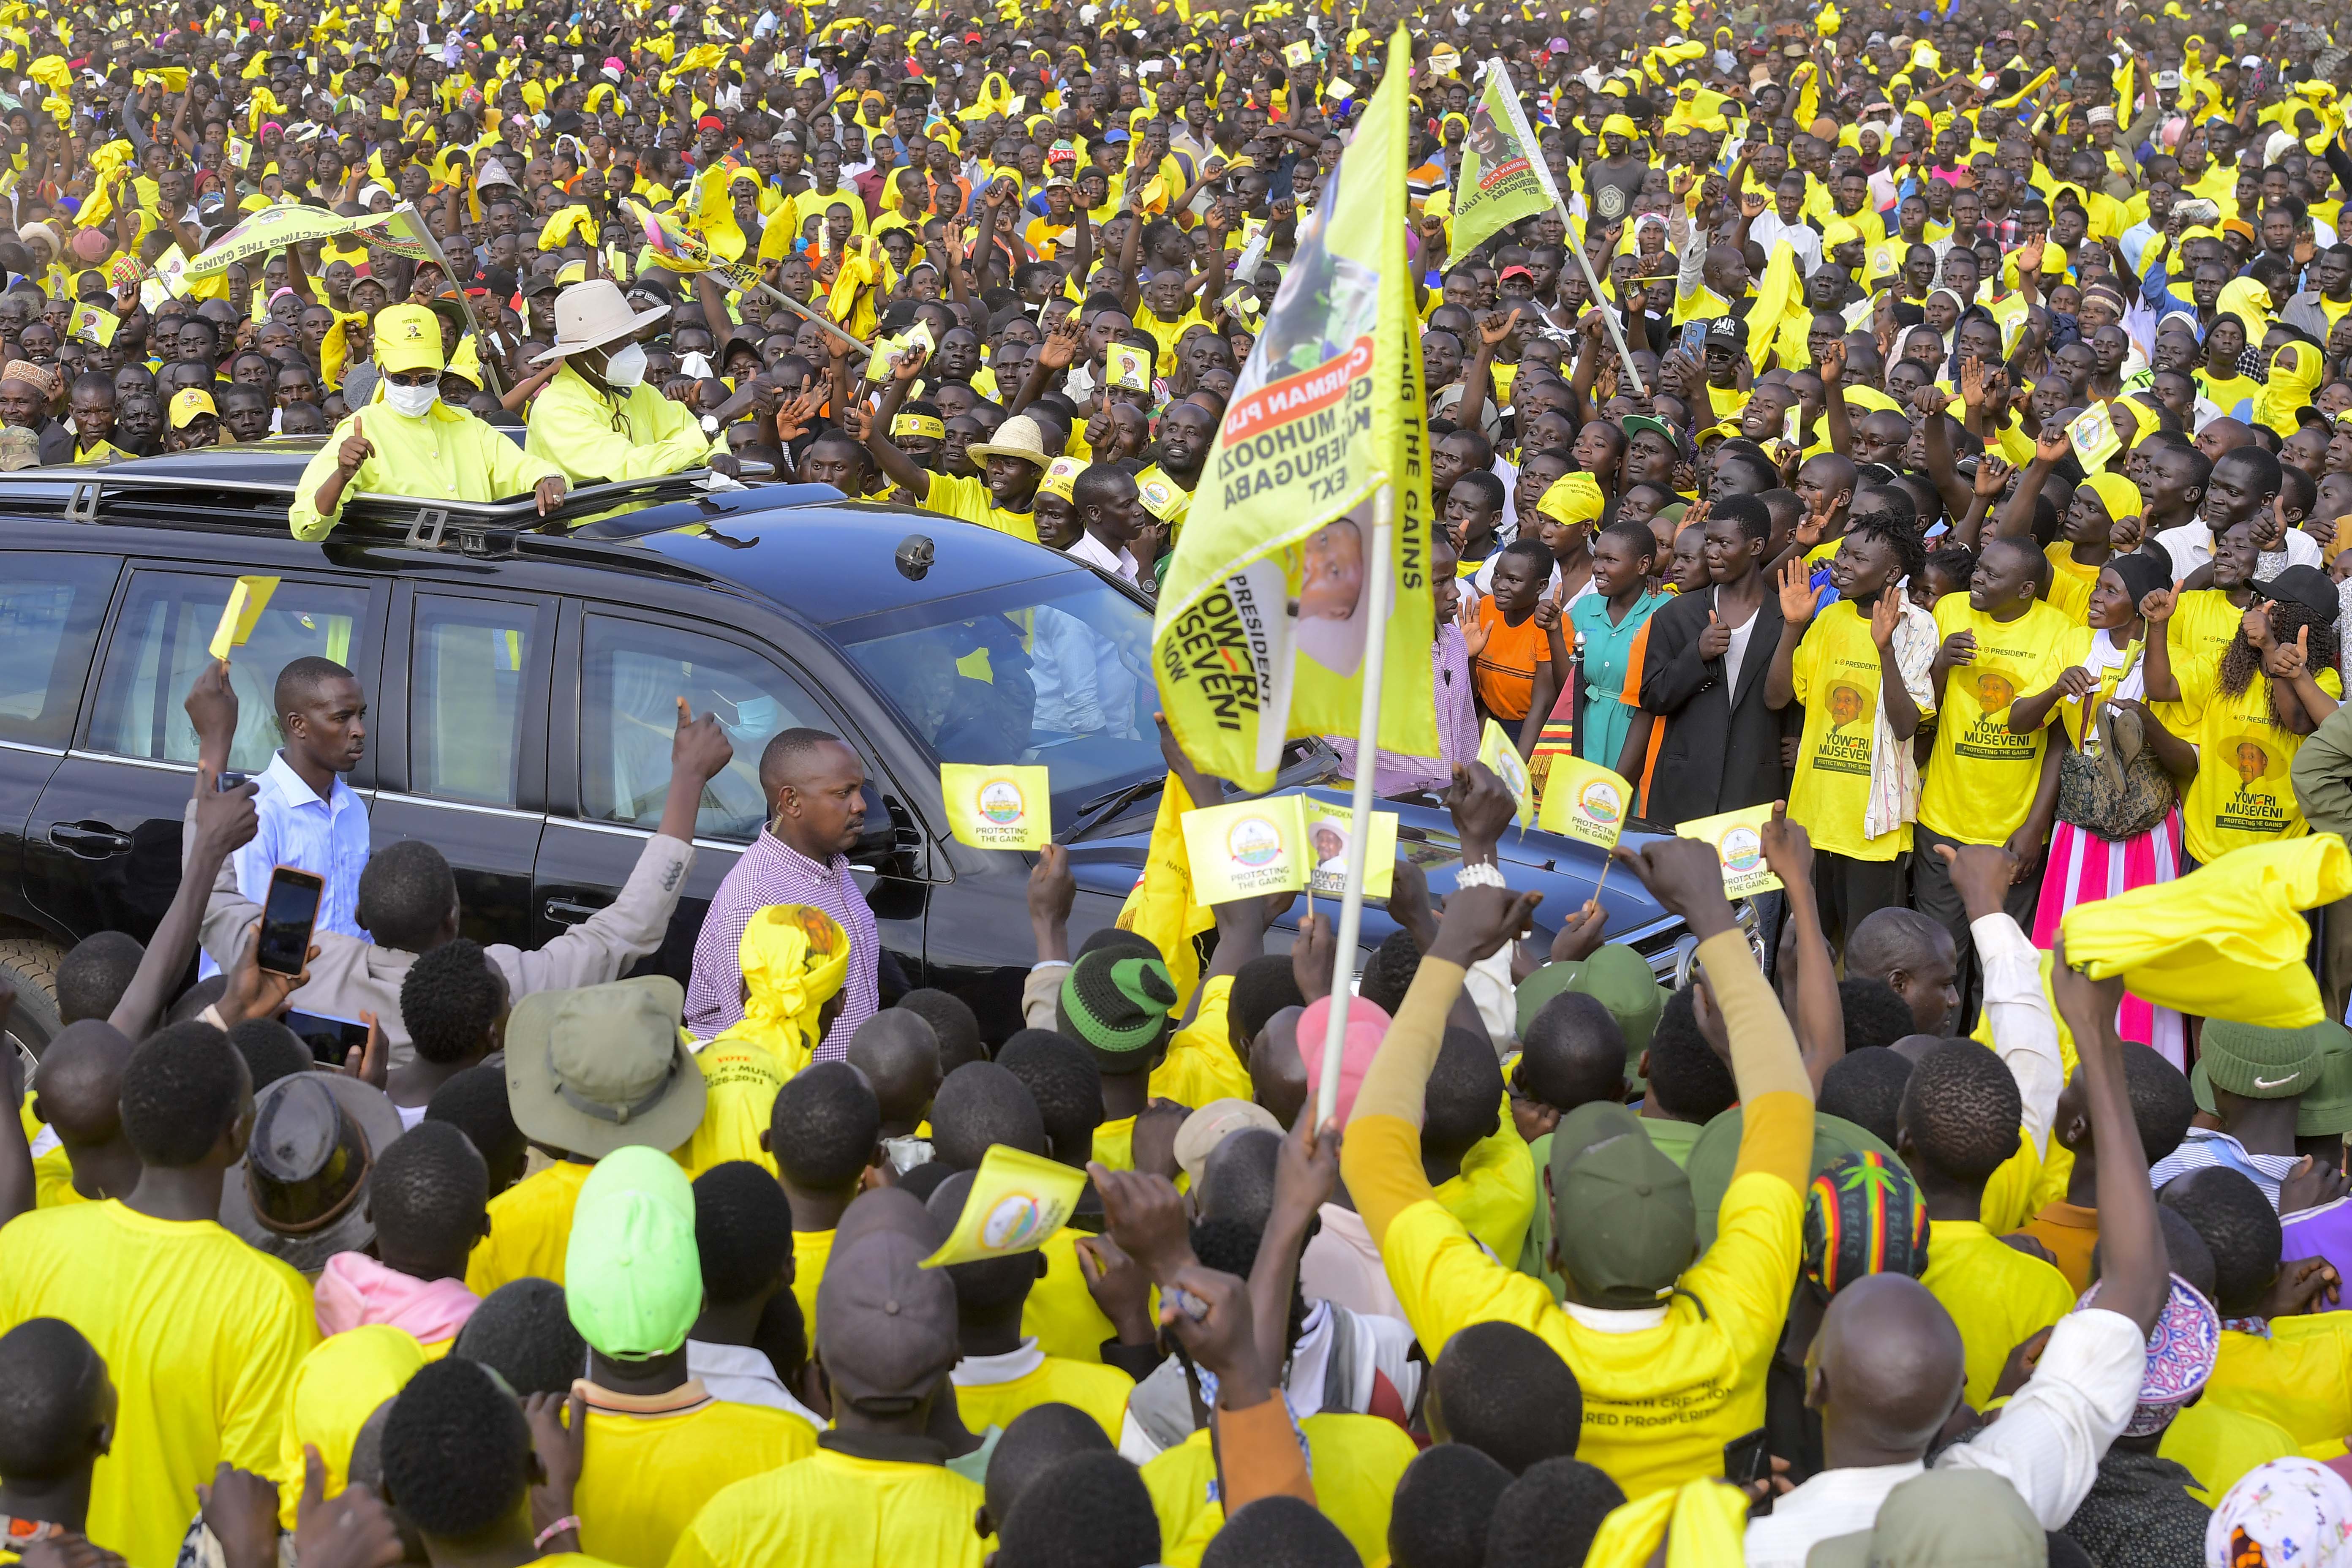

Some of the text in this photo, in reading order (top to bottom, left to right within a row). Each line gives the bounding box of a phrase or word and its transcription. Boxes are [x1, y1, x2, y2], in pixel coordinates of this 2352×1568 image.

[238, 240, 265, 256] THE
[195, 250, 235, 272] GAINS
[88, 305, 106, 315] PRESIDENT
[1712, 317, 1735, 332] AIR
[1712, 329, 1734, 337] JORDAN
[1119, 379, 1140, 388] MUSEVENI
[1121, 375, 1138, 383] YOWERI
[1403, 416, 1421, 479] THE
[1571, 489, 1597, 501] MOVEMENT
[1581, 485, 1603, 498] RESISTAN
[1402, 490, 1422, 590] GAINS
[1229, 575, 1270, 706] PRESIDENT
[1165, 637, 1190, 683] NOW
[1990, 648, 2028, 658] PRESIDENT
[1176, 606, 1241, 731] SEVENI
[1845, 660, 1877, 670] PRESIDENT
[2246, 715, 2273, 724] PRESIDE
[1825, 733, 1869, 750] YOWERI
[1964, 731, 2030, 746] MUSEVENI
[1963, 746, 1998, 755] PROTECTING
[1818, 759, 1846, 767] PROTECTING
[2234, 791, 2276, 807] YOWERI
[1318, 805, 1353, 820] PRESIDEN
[2225, 803, 2283, 818] MUSEVENI
[976, 827, 1028, 835] PROTECTING
[1575, 825, 1614, 845] THE GAINS
[1231, 866, 1289, 882] PROTECTING
[1258, 875, 1287, 886] GAINS
[1729, 878, 1769, 894] THE GAINS
[708, 1075, 763, 1088] 026-2031
